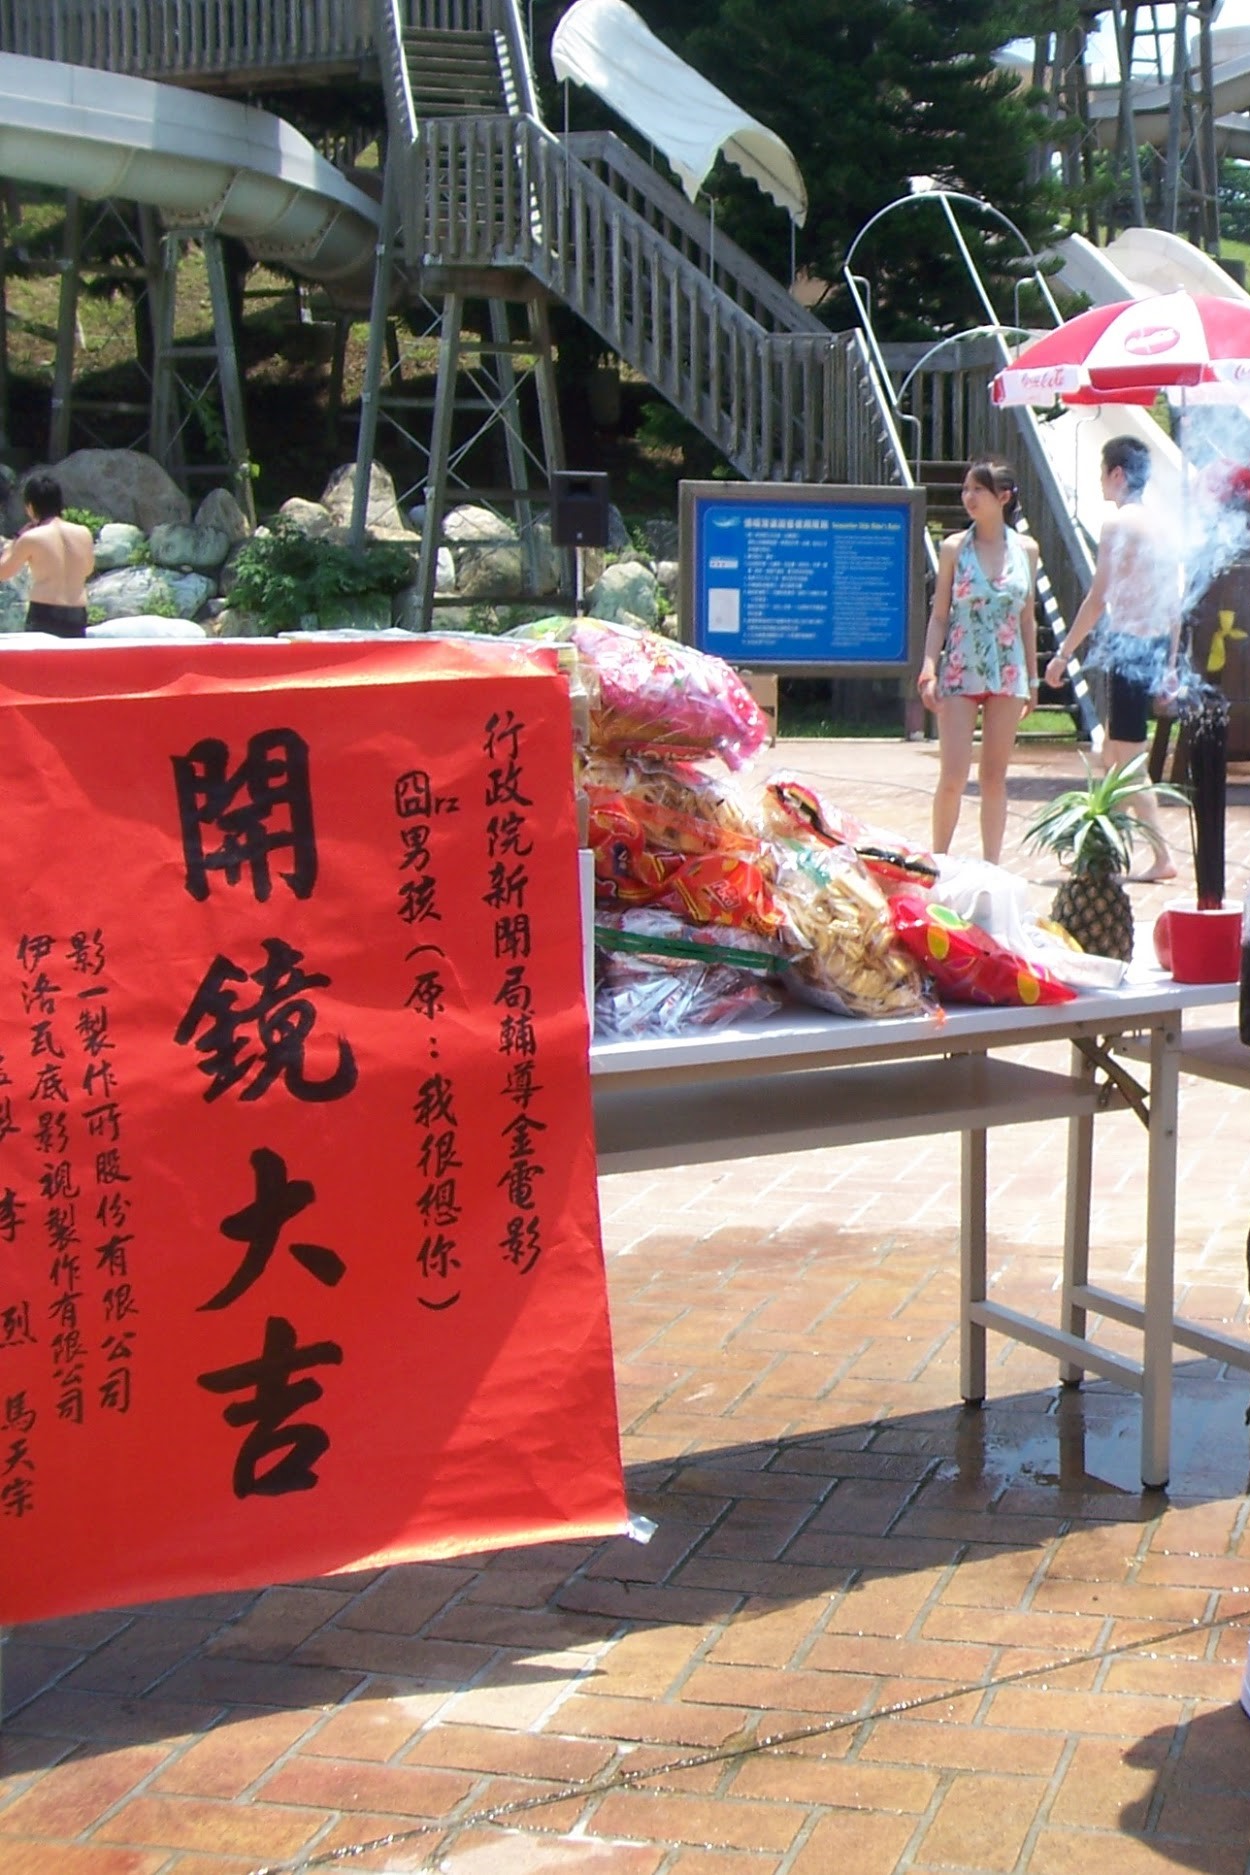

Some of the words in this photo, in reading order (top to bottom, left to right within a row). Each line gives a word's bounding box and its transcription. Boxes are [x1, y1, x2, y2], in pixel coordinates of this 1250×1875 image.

[17, 934, 88, 1424] 伊洛瓦底影視製作有限公司
[66, 928, 139, 1414] 影一製作所股份有限公司
[172, 728, 359, 1500] 開鏡大吉
[481, 711, 548, 1275] 行政院新聞局輔導金電影
